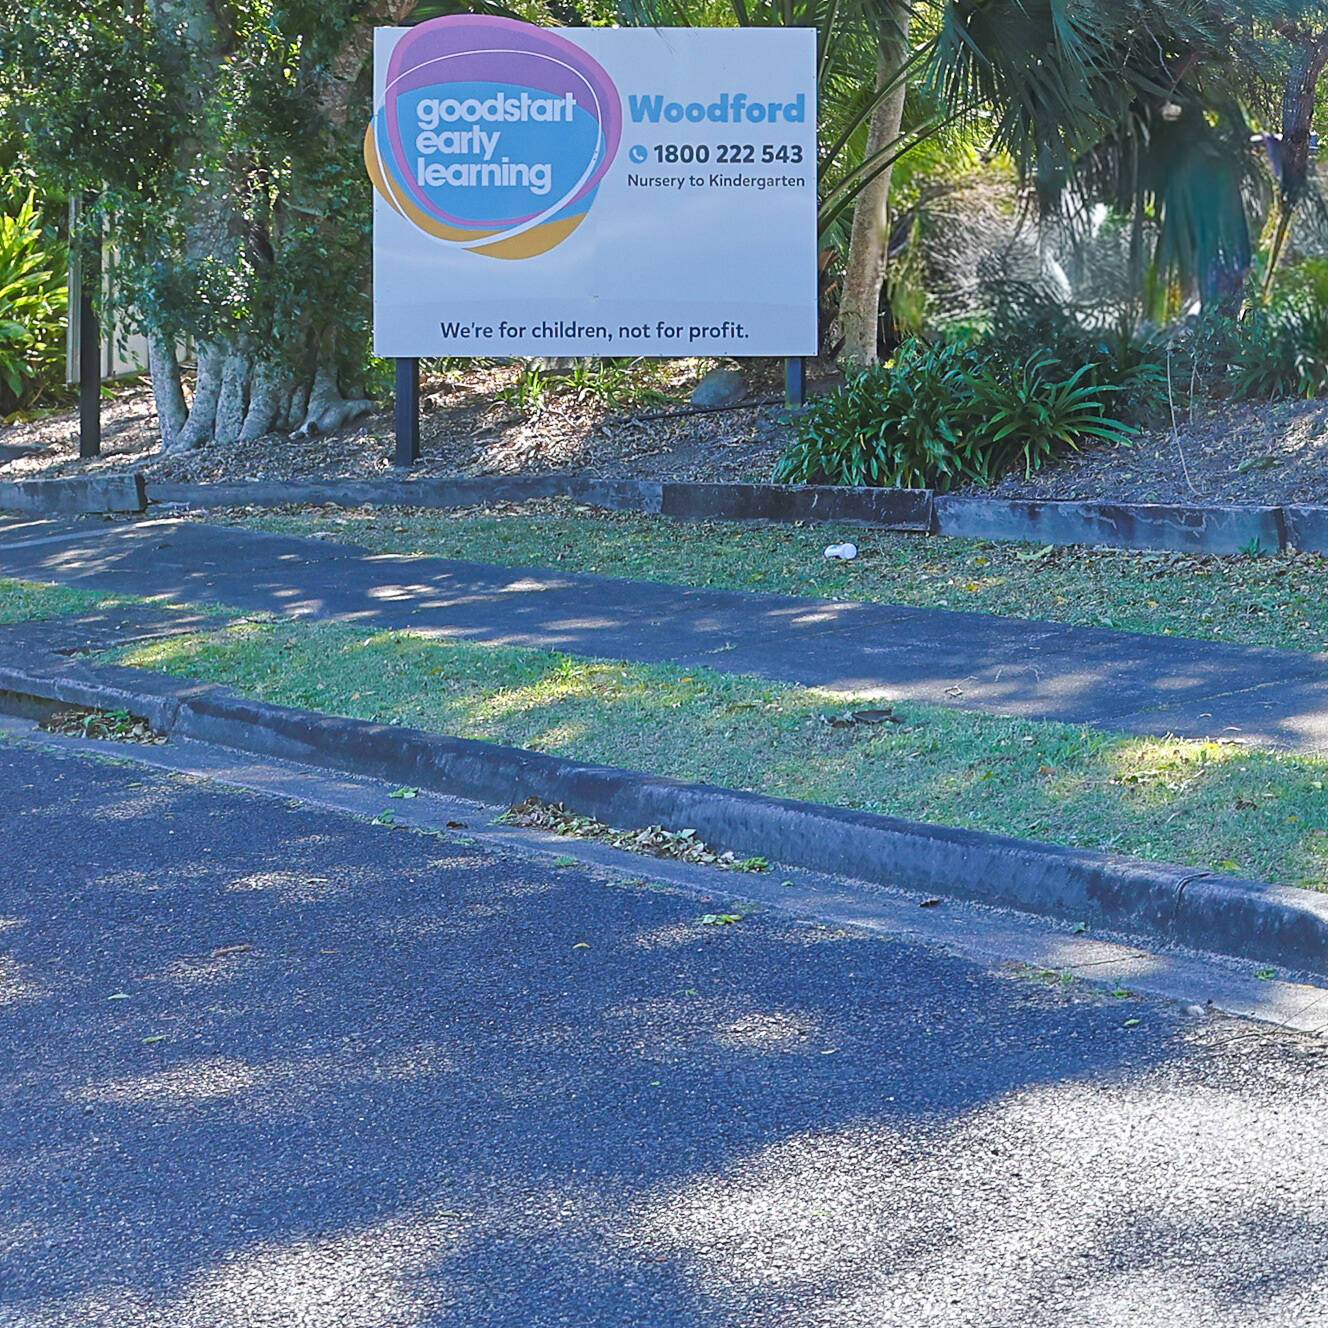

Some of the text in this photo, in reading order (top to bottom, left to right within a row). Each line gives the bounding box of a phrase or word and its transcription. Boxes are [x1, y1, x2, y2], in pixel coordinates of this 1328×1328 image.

[416, 92, 577, 131] goodstart
[628, 93, 805, 123] Woodford
[416, 125, 501, 161] early
[653, 144, 803, 164] 1800 222 543
[417, 157, 552, 195] learning
[628, 174, 805, 189] Nursery to Kindergarten
[441, 321, 750, 342] We're for children, not for profit.
